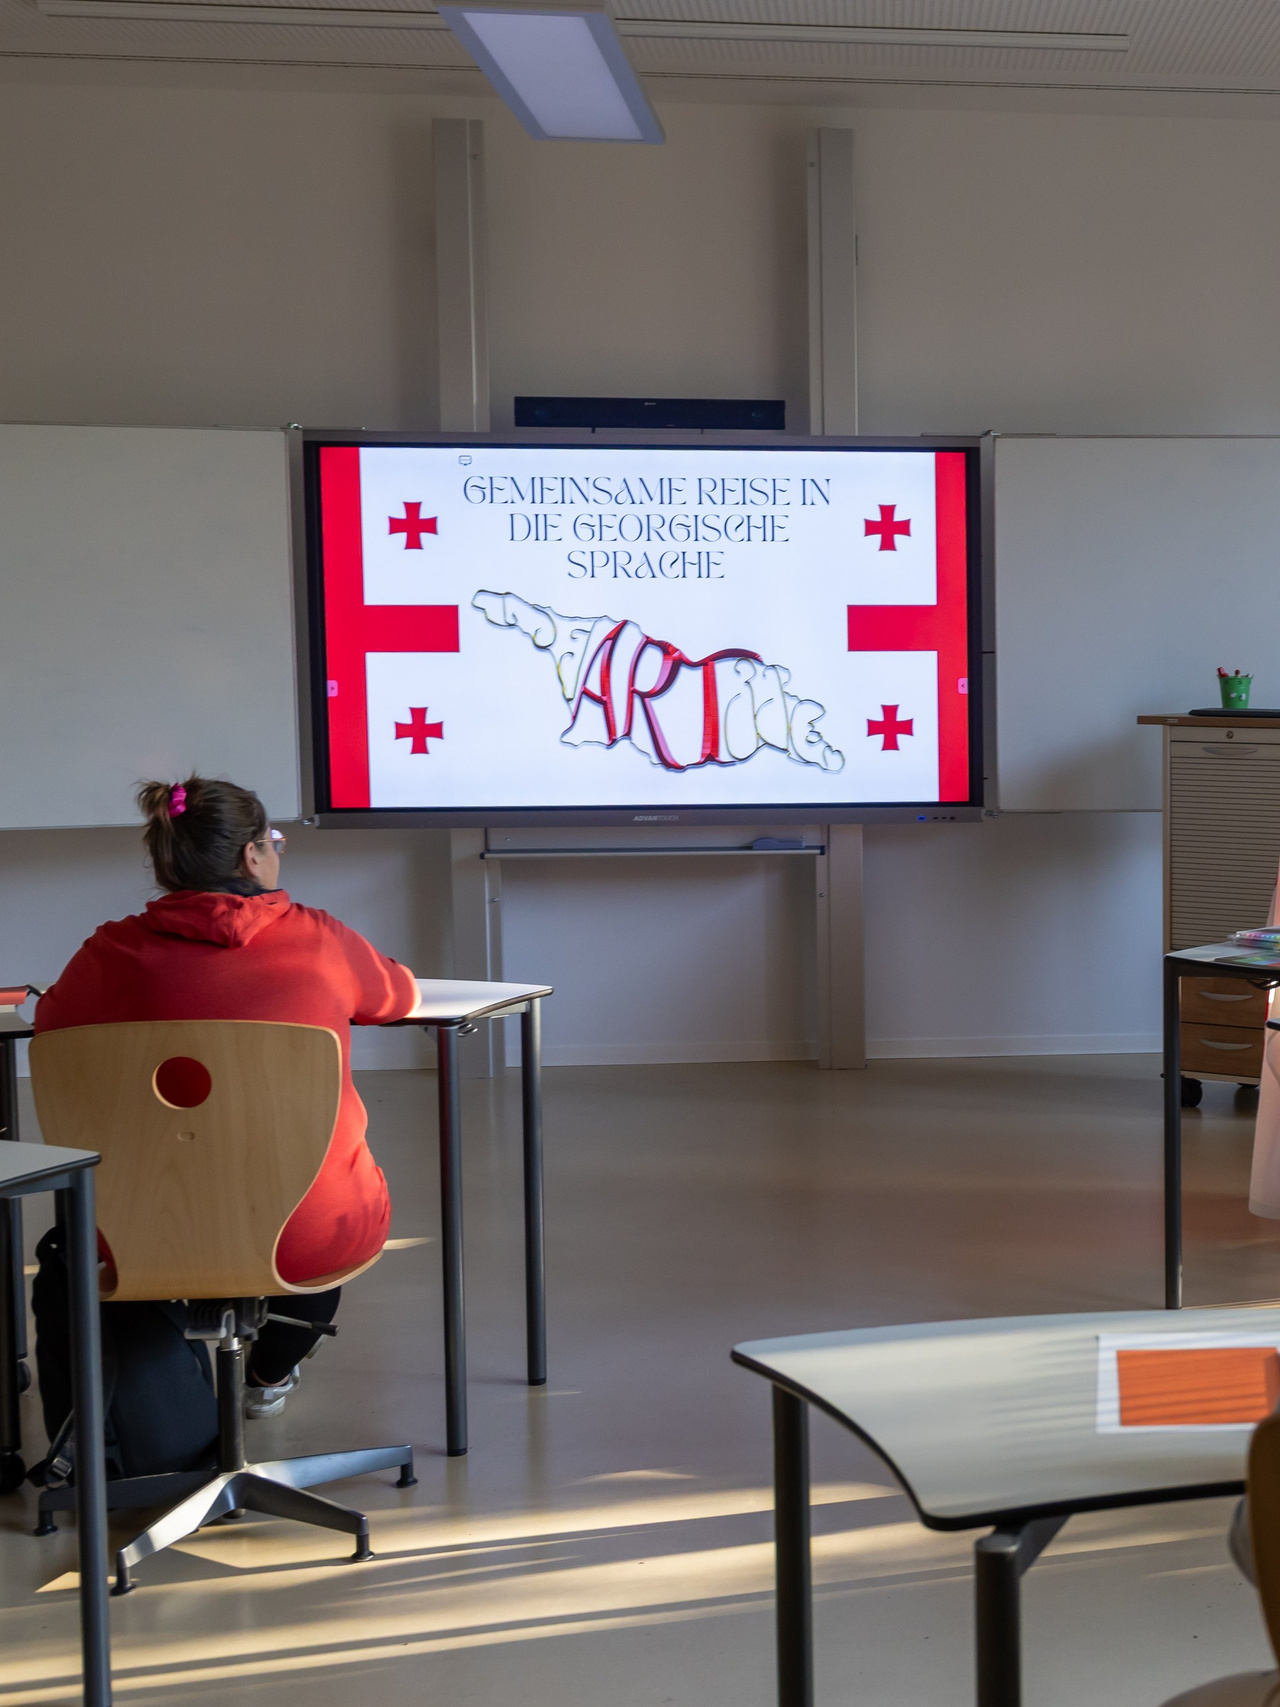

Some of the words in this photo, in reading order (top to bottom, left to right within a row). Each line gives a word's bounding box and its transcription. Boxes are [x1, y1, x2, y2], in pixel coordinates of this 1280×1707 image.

[462, 475, 687, 506] GEMEINSAME
[696, 476, 791, 506] REISE
[800, 476, 832, 506] IN
[508, 513, 563, 543] DIE
[572, 513, 790, 543] GEORGISCHE
[566, 549, 725, 579] SPRACHE
